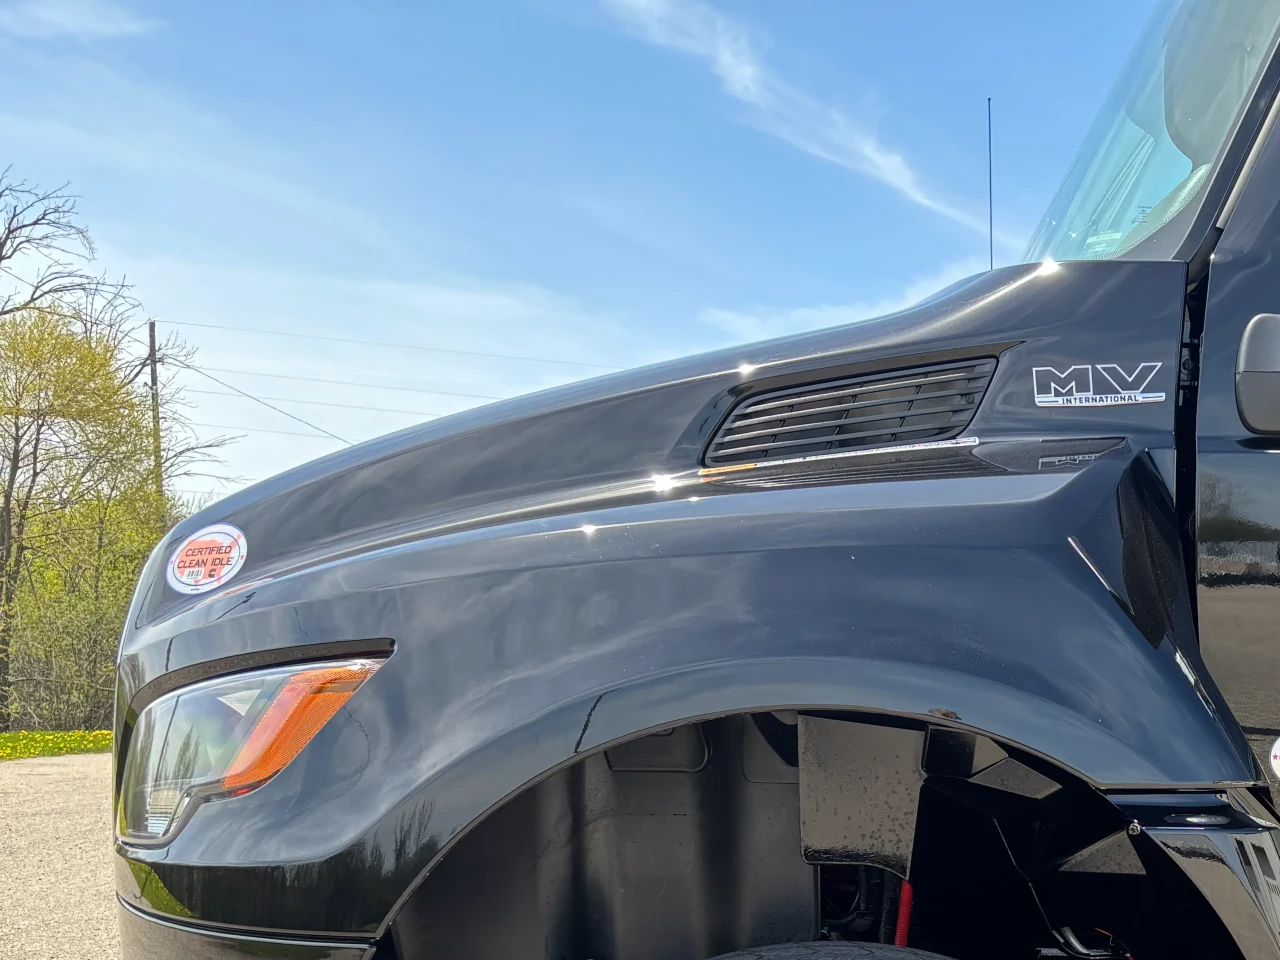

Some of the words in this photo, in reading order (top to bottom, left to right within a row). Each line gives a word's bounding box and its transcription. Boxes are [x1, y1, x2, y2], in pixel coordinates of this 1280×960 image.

[1032, 362, 1163, 396] MV
[1062, 394, 1139, 405] INTERNATIONAL
[185, 545, 232, 557] CERTIFIED
[177, 559, 208, 569] CLEAN
[211, 556, 234, 567] IDLE
